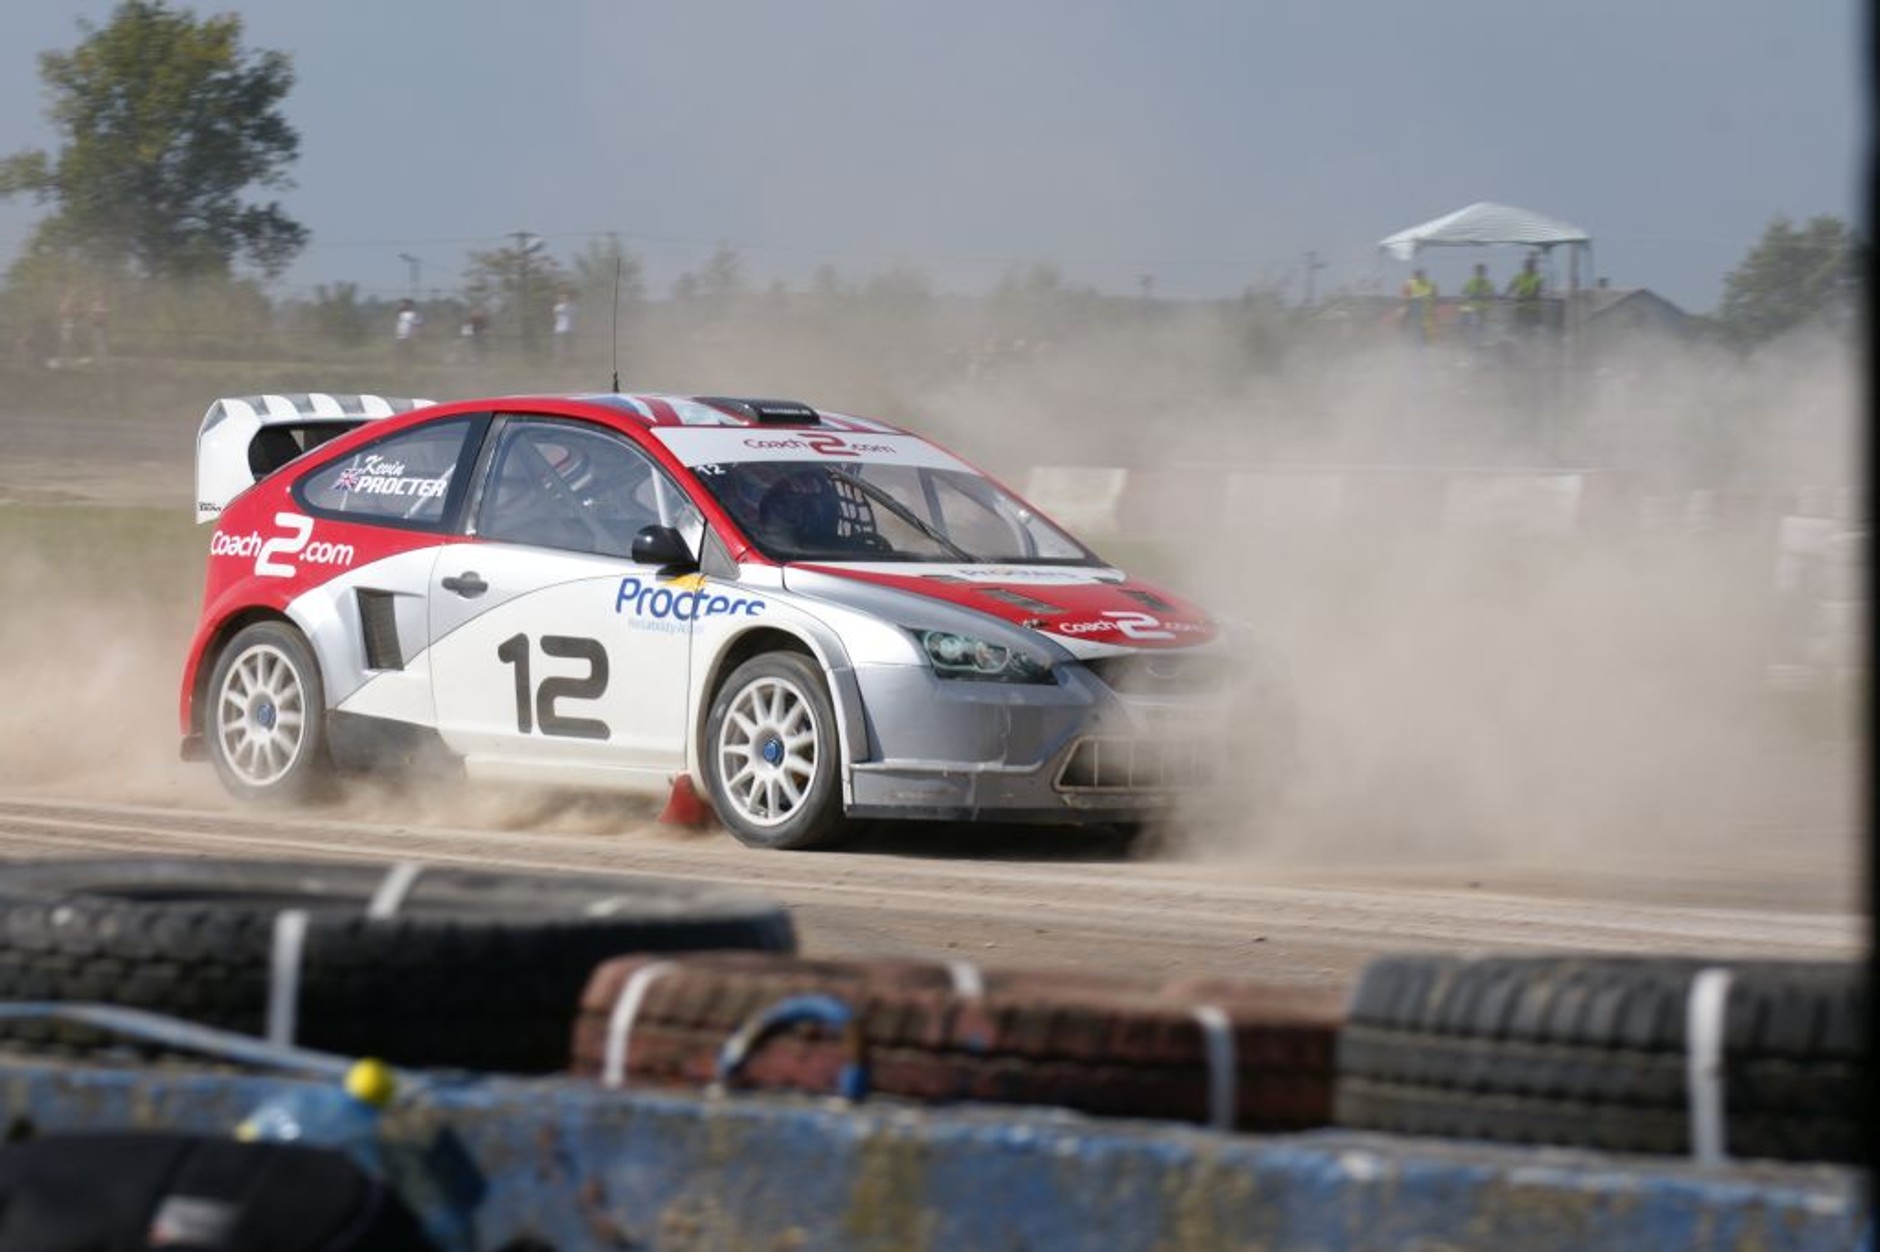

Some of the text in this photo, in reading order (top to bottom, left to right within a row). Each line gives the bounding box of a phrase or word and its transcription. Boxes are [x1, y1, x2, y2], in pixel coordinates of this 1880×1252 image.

[354, 475, 448, 497] PROCTER
[364, 455, 406, 476] Kevin
[210, 511, 355, 579] Coach2.com
[615, 577, 767, 621] Procters
[497, 632, 612, 741] 12
